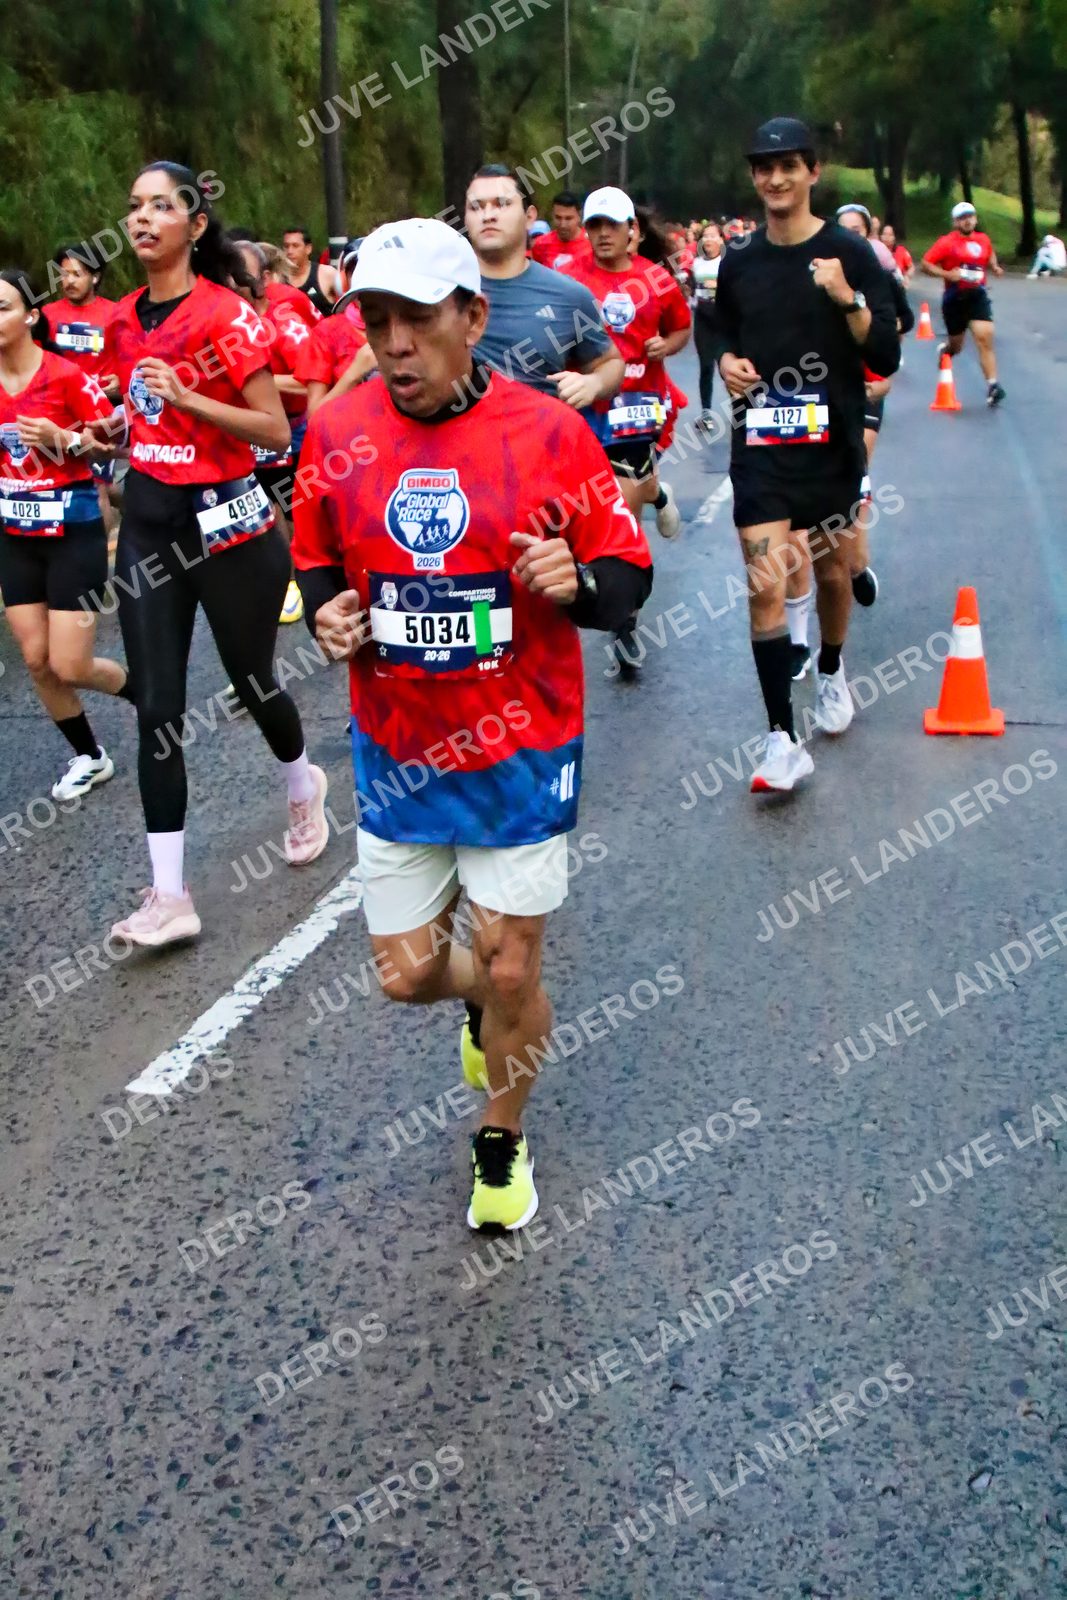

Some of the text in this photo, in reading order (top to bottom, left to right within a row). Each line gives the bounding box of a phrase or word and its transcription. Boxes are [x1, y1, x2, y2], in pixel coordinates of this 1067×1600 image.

[626, 406, 652, 419] 4248
[772, 408, 802, 424] 4127
[406, 477, 451, 489] BIMBO
[228, 490, 263, 520] 4899
[406, 493, 450, 509] Global
[12, 502, 41, 518] 4028
[398, 507, 433, 522] Race
[416, 557, 441, 568] 2026
[405, 615, 471, 644] 5034
[424, 649, 451, 661] 20-26
[477, 659, 500, 671] 10K
